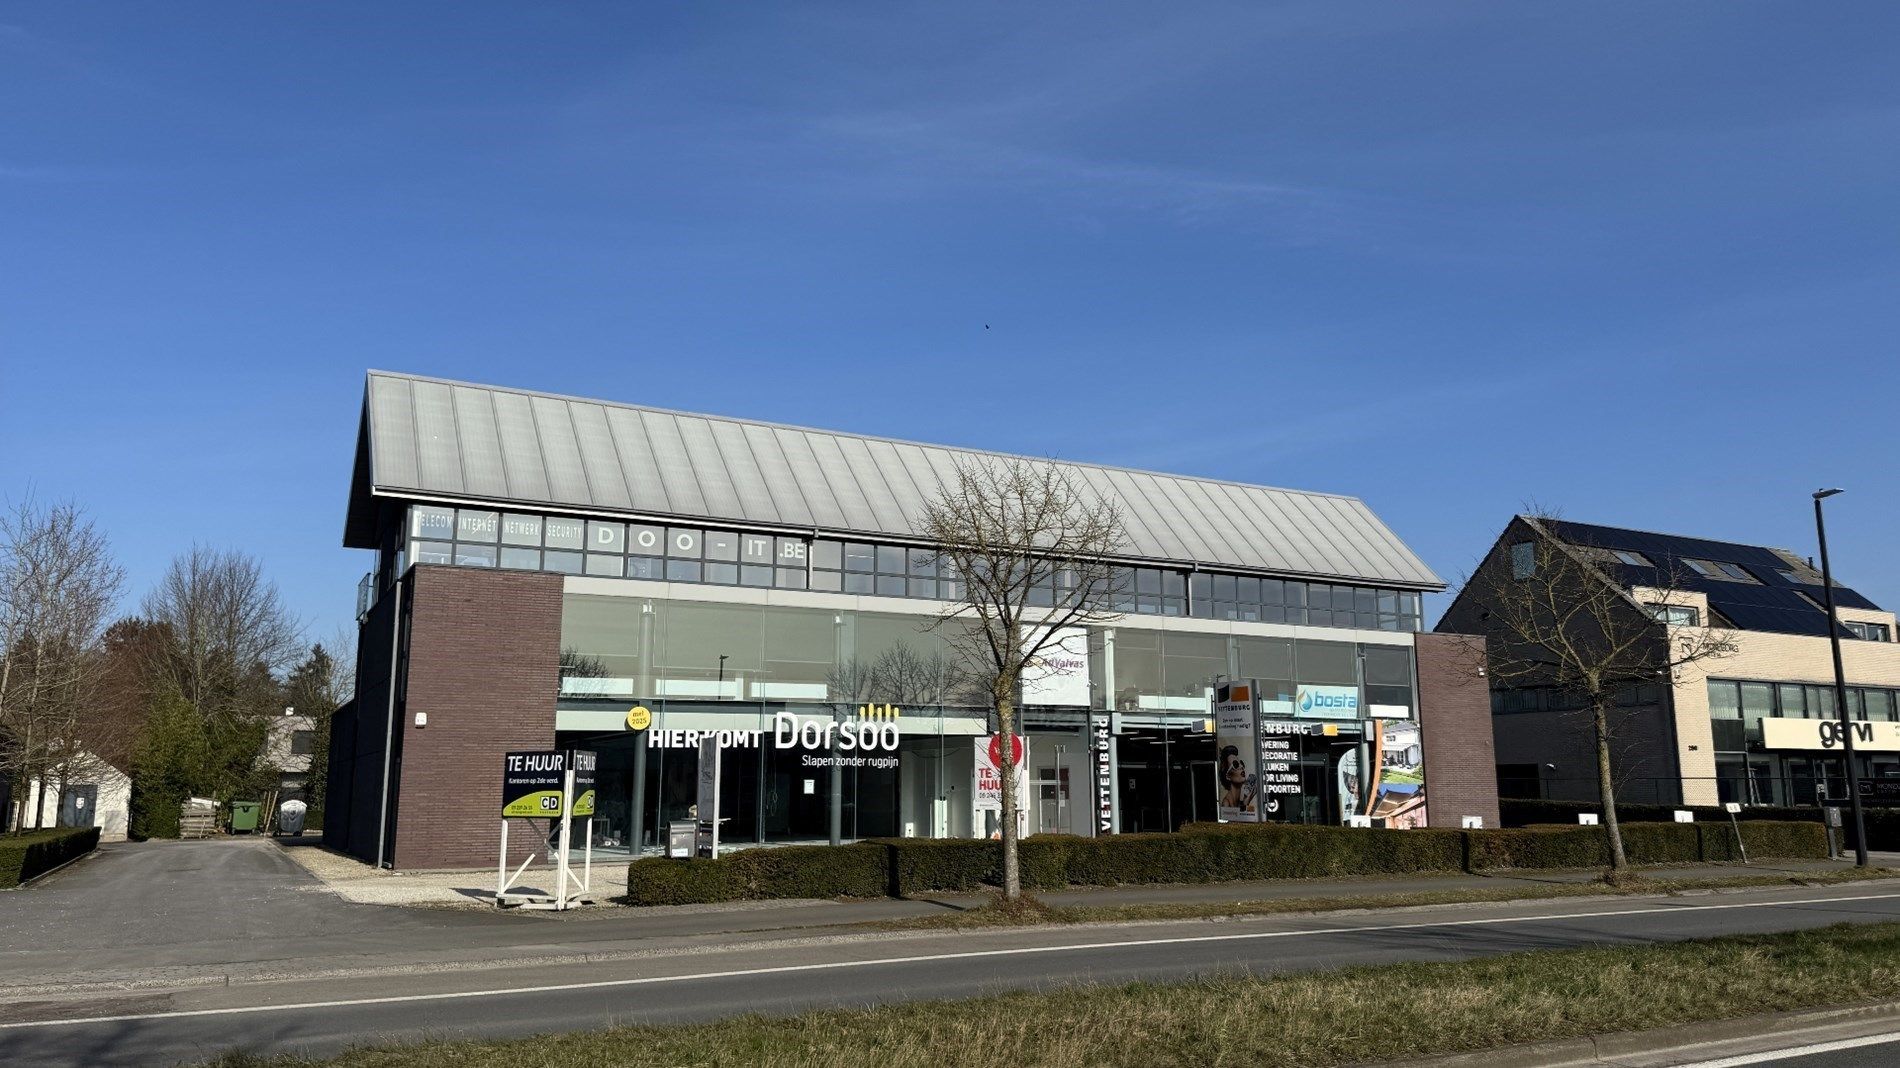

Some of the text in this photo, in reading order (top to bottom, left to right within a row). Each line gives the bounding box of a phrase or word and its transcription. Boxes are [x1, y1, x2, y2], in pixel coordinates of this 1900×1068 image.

[458, 516, 497, 533] INTERNET
[503, 520, 540, 536] NETWERK
[547, 524, 582, 540] SECURITY
[1314, 691, 1357, 709] bosta
[648, 730, 700, 748] HIER
[775, 711, 900, 751] Dorsoo
[507, 754, 563, 772] TE HUUR
[576, 754, 583, 771] TE
[801, 754, 899, 769] Slapen zonder rugpijn
[978, 768, 993, 779] TE
[1098, 715, 1111, 831] VETTENBURG
[1275, 773, 1299, 783] LIVING
[978, 779, 1002, 791] HUU
[541, 796, 558, 810] CD
